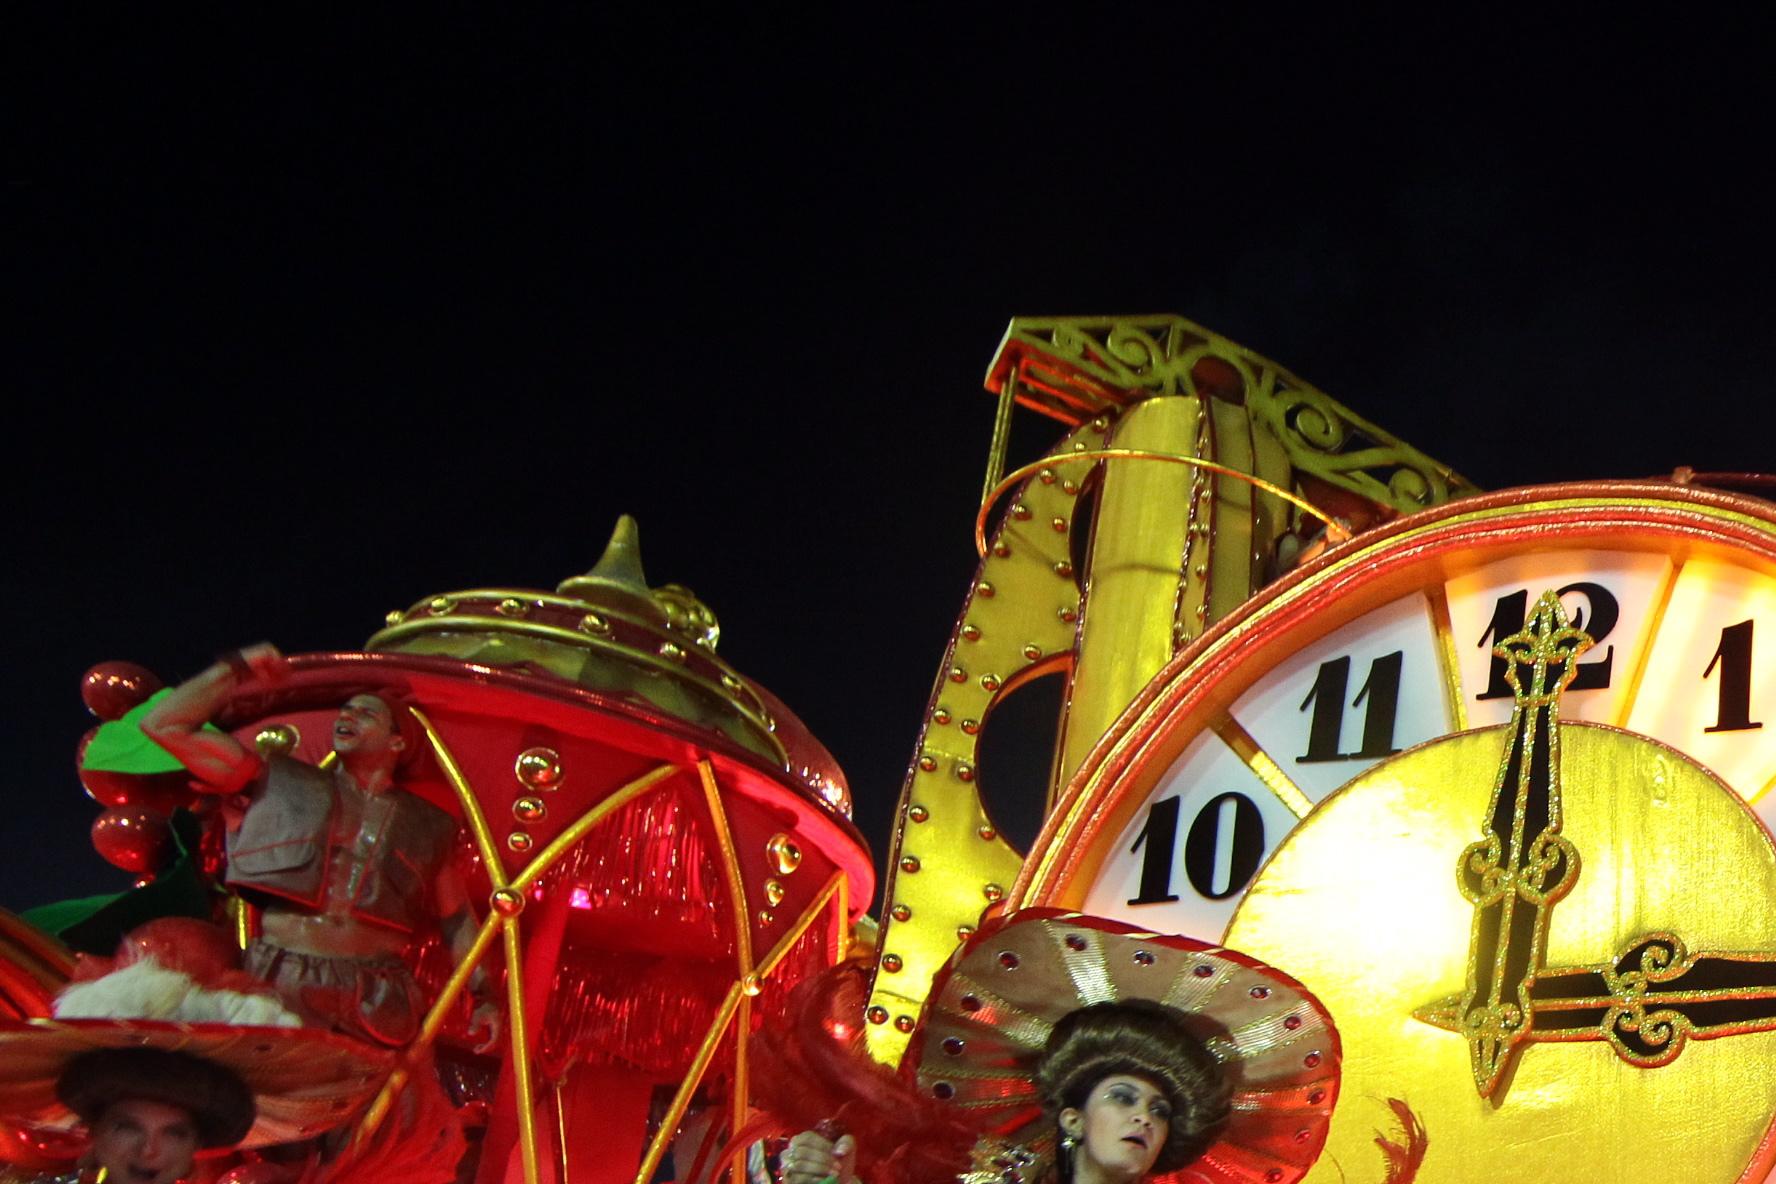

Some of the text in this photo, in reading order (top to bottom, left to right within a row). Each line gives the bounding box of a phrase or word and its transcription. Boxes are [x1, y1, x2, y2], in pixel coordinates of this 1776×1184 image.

[1476, 582, 1619, 700] 12
[1704, 619, 1763, 732] 1
[1294, 649, 1404, 764] 11
[1127, 791, 1266, 906] 10
